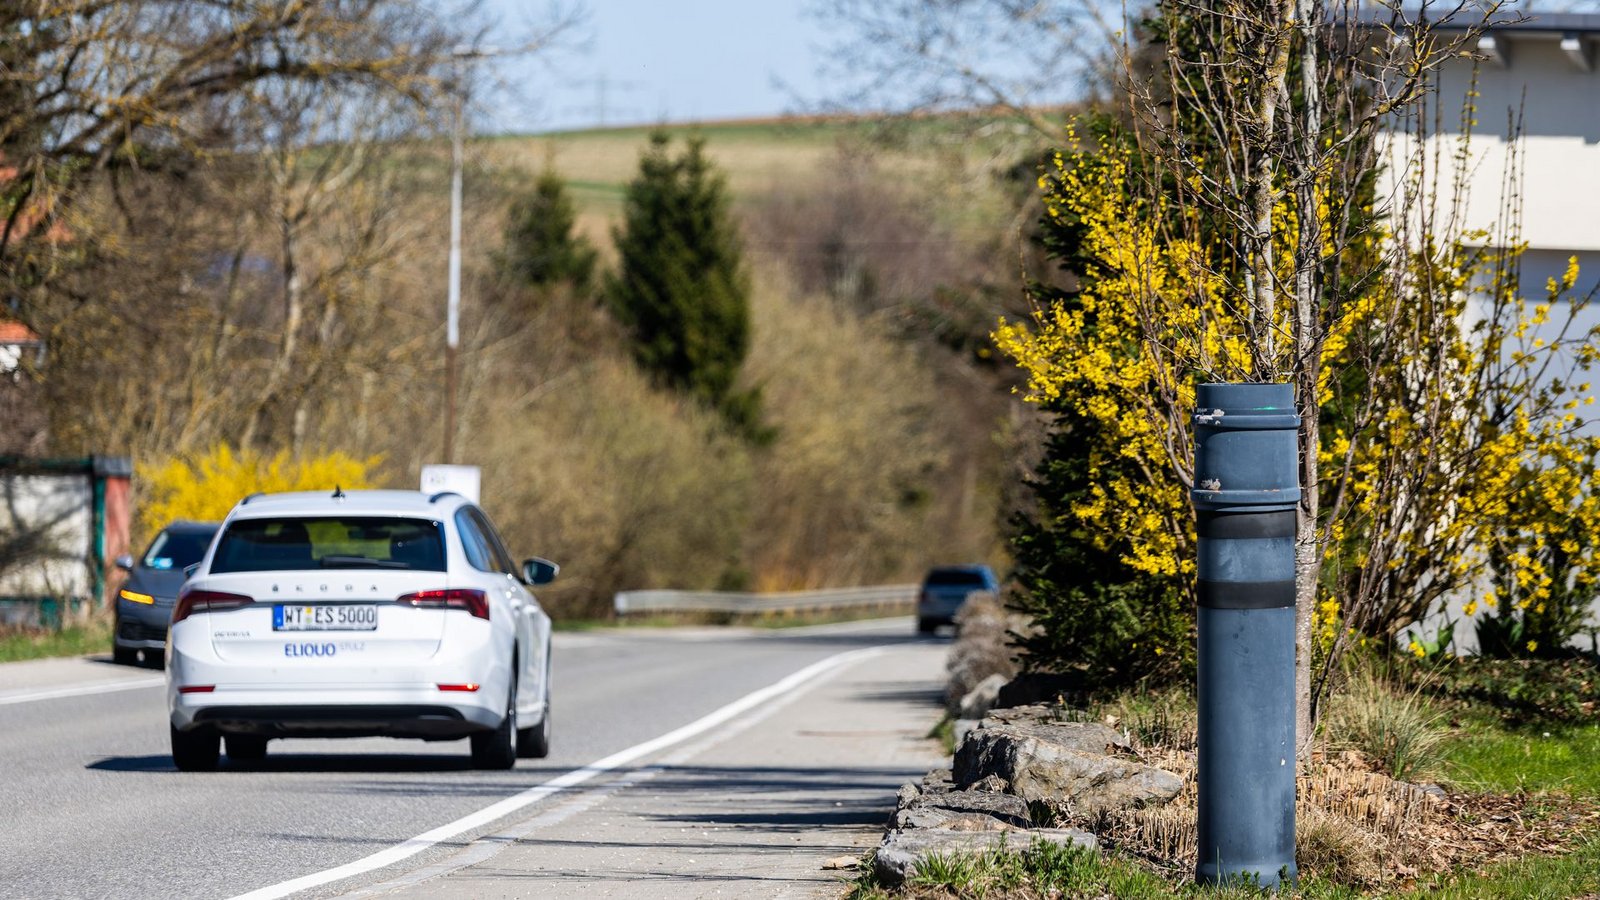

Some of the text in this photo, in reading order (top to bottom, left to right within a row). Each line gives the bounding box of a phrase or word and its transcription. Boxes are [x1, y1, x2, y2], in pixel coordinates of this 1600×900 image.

[285, 606, 375, 623] WT ES 5000
